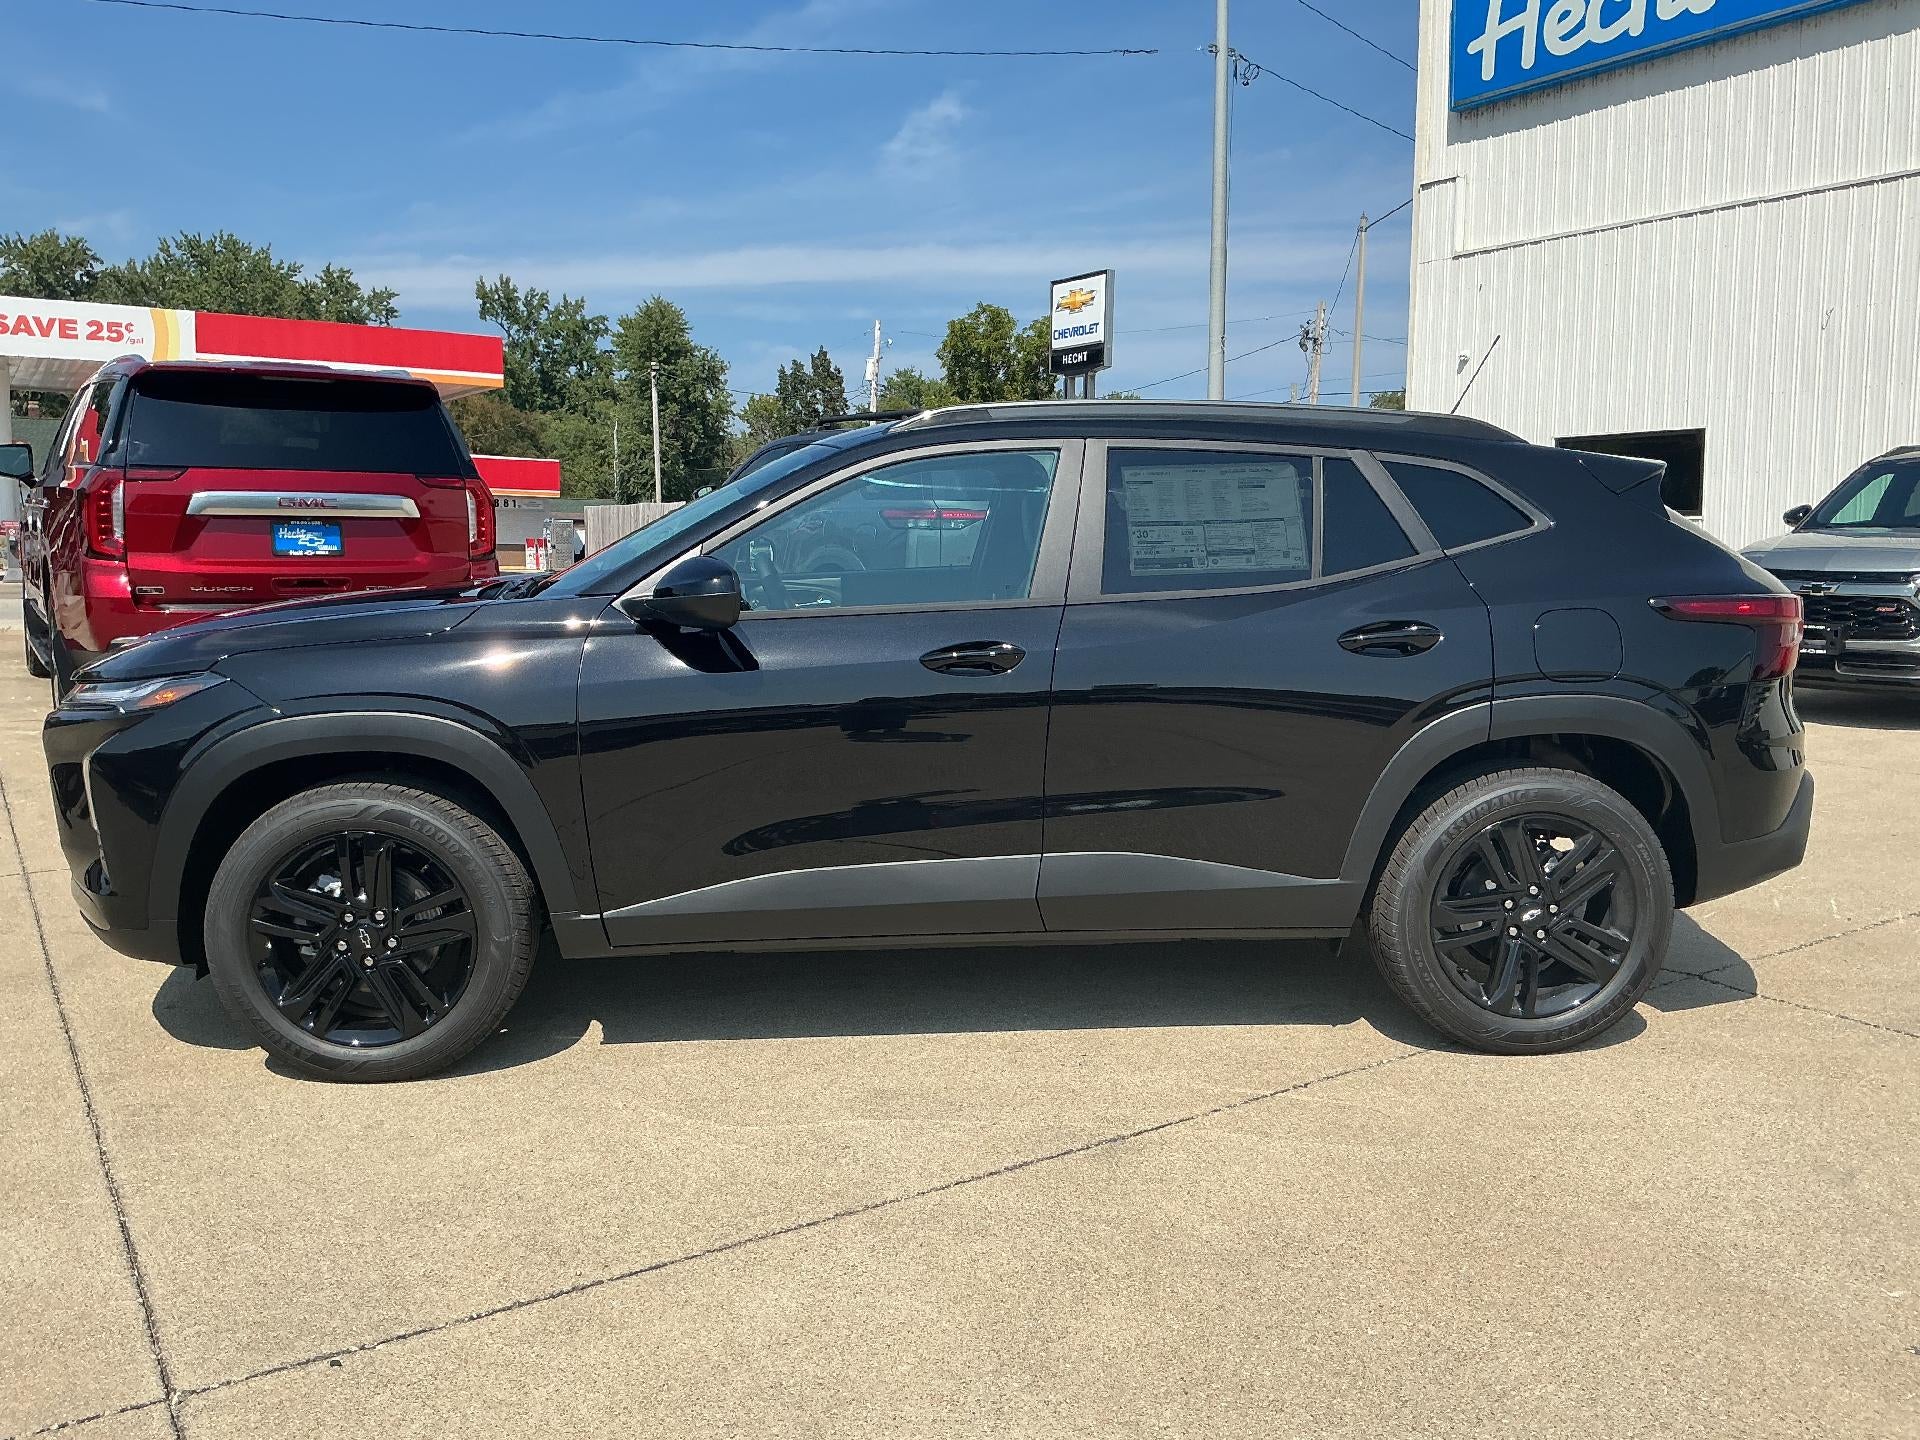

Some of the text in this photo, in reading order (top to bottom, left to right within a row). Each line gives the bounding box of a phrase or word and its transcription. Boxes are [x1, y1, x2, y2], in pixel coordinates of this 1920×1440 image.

[1467, 0, 1716, 81] Hec
[0, 313, 79, 340] SAVE
[1053, 322, 1100, 341] CHEVROLET
[1062, 350, 1088, 365] HECHT
[277, 497, 339, 509] GMC
